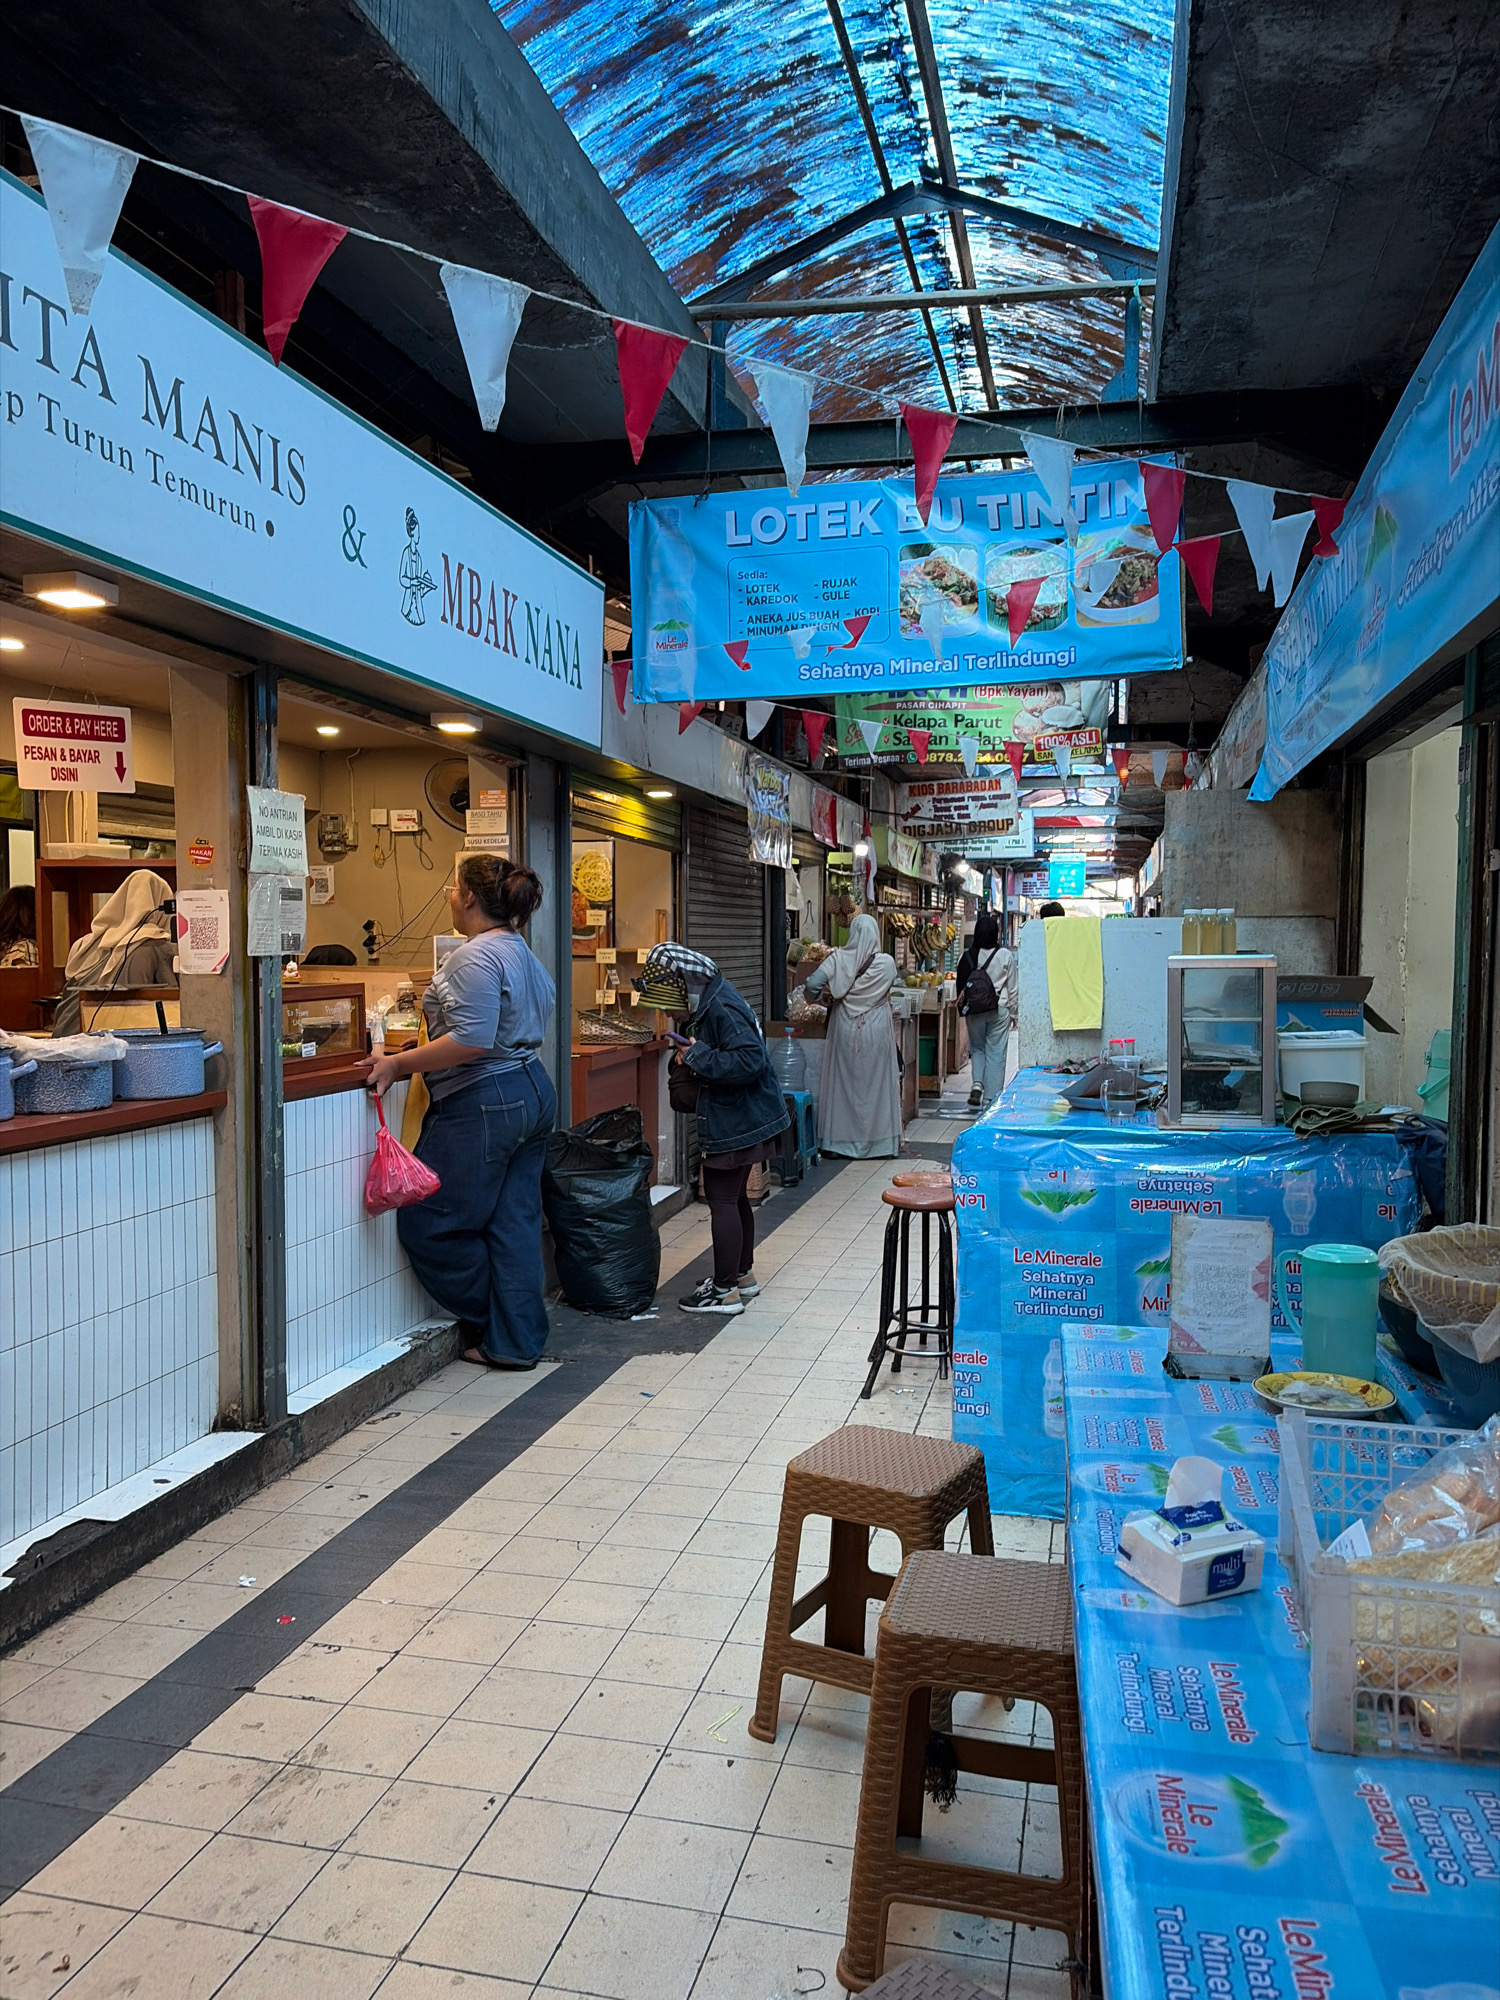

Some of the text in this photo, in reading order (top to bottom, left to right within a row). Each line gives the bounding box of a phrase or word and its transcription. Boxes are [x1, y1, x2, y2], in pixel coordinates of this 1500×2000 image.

[137, 354, 306, 506] MANIS
[37, 392, 136, 476] Turun
[145, 448, 257, 533] Temurun
[725, 498, 884, 548] LOTEK
[898, 496, 963, 533] BU
[342, 504, 368, 569] &
[737, 570, 768, 580] Sedia:
[822, 577, 858, 589] RUJAK
[746, 584, 780, 594] LOTEK
[822, 591, 850, 602] GULE
[746, 594, 799, 607] KAREDOK
[440, 551, 582, 690] MBAK NANA
[747, 611, 840, 625] ANEKA JUS BUAH
[747, 625, 798, 637] MINUMAN
[799, 647, 1077, 681] Sehatnya Mineral Terlindungi
[896, 701, 967, 710] PASAR CIHAPIT
[28, 714, 119, 738] ORDER & PAY HERE
[893, 713, 948, 731] Kelapa
[954, 714, 1002, 729] Parut
[1038, 731, 1096, 749] 100% ASLI
[24, 745, 101, 764] PESAN & BAYAR
[844, 757, 870, 767] Terima
[51, 766, 79, 782] DISINI
[909, 778, 1002, 798] KIOS BARABADAN
[258, 806, 298, 822] NO ANTRIAN
[256, 825, 303, 842] AMBIL DI KASIR
[967, 817, 1014, 834] GROUP
[259, 845, 303, 860] TERIMA KASIH
[1137, 1181, 1214, 1195] Sehatnya
[1130, 1198, 1201, 1214] Minerale
[1014, 1248, 1102, 1267] Le Minerale
[1021, 1269, 1096, 1287] Sehatnya
[1030, 1286, 1087, 1302] Mineral
[1014, 1301, 1104, 1320] Terlindungi
[1103, 1463, 1125, 1493] Minerale
[1121, 1473, 1140, 1483] Le
[1212, 1555, 1241, 1575] multi
[1116, 1652, 1153, 1735] Terlindungi
[1149, 1667, 1183, 1723] Mineral
[1177, 1665, 1210, 1733] Sehatnya
[1209, 1661, 1257, 1744] Le Minerale
[1155, 1773, 1197, 1855] Minerale
[1187, 1803, 1218, 1827] Le
[1355, 1782, 1417, 1864] Minerale
[1406, 1794, 1467, 1887] Sehatnya
[1440, 1805, 1500, 1880] Mineral
